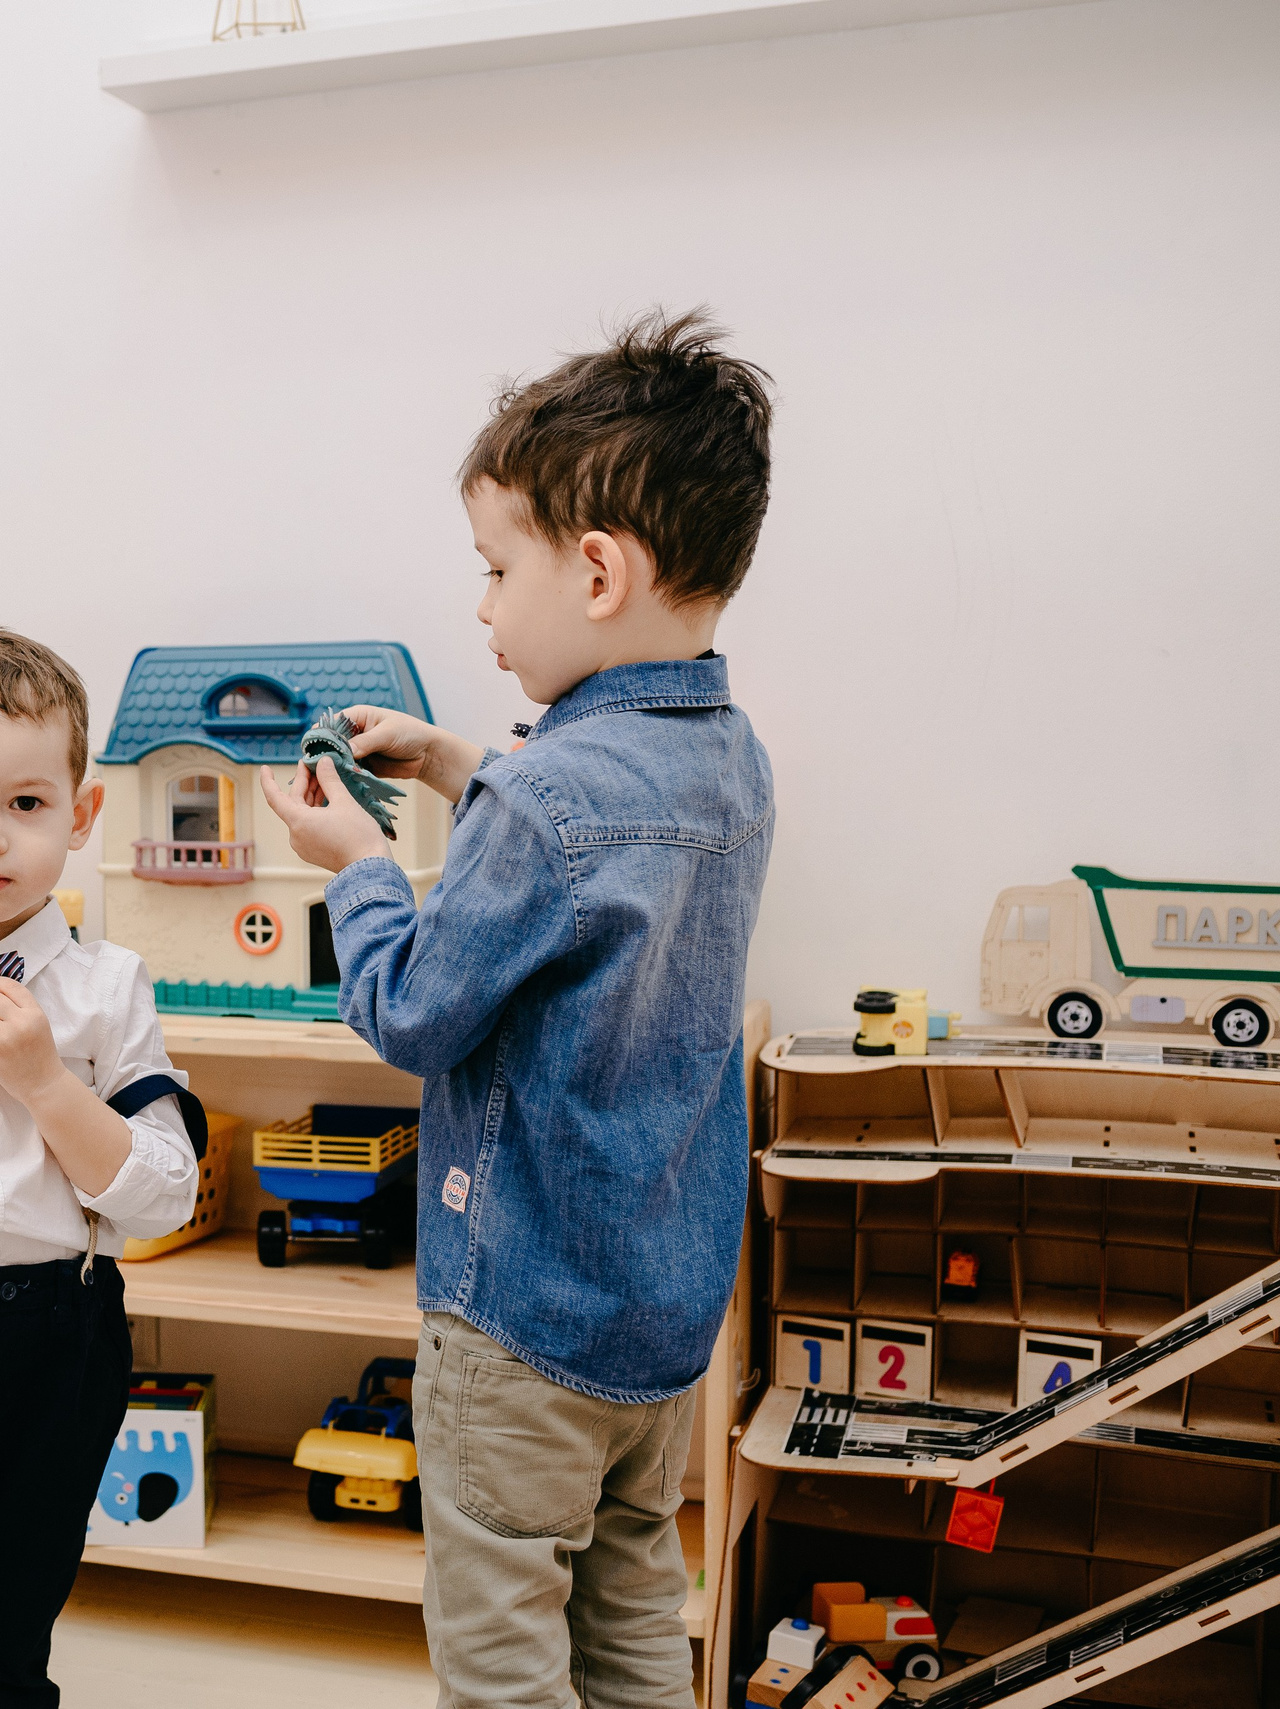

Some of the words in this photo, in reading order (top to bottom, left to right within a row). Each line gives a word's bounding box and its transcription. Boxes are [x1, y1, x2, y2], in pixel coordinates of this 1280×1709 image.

[1157, 904, 1280, 946] ПАРК
[802, 1339, 821, 1385] 1
[878, 1344, 907, 1391] 2
